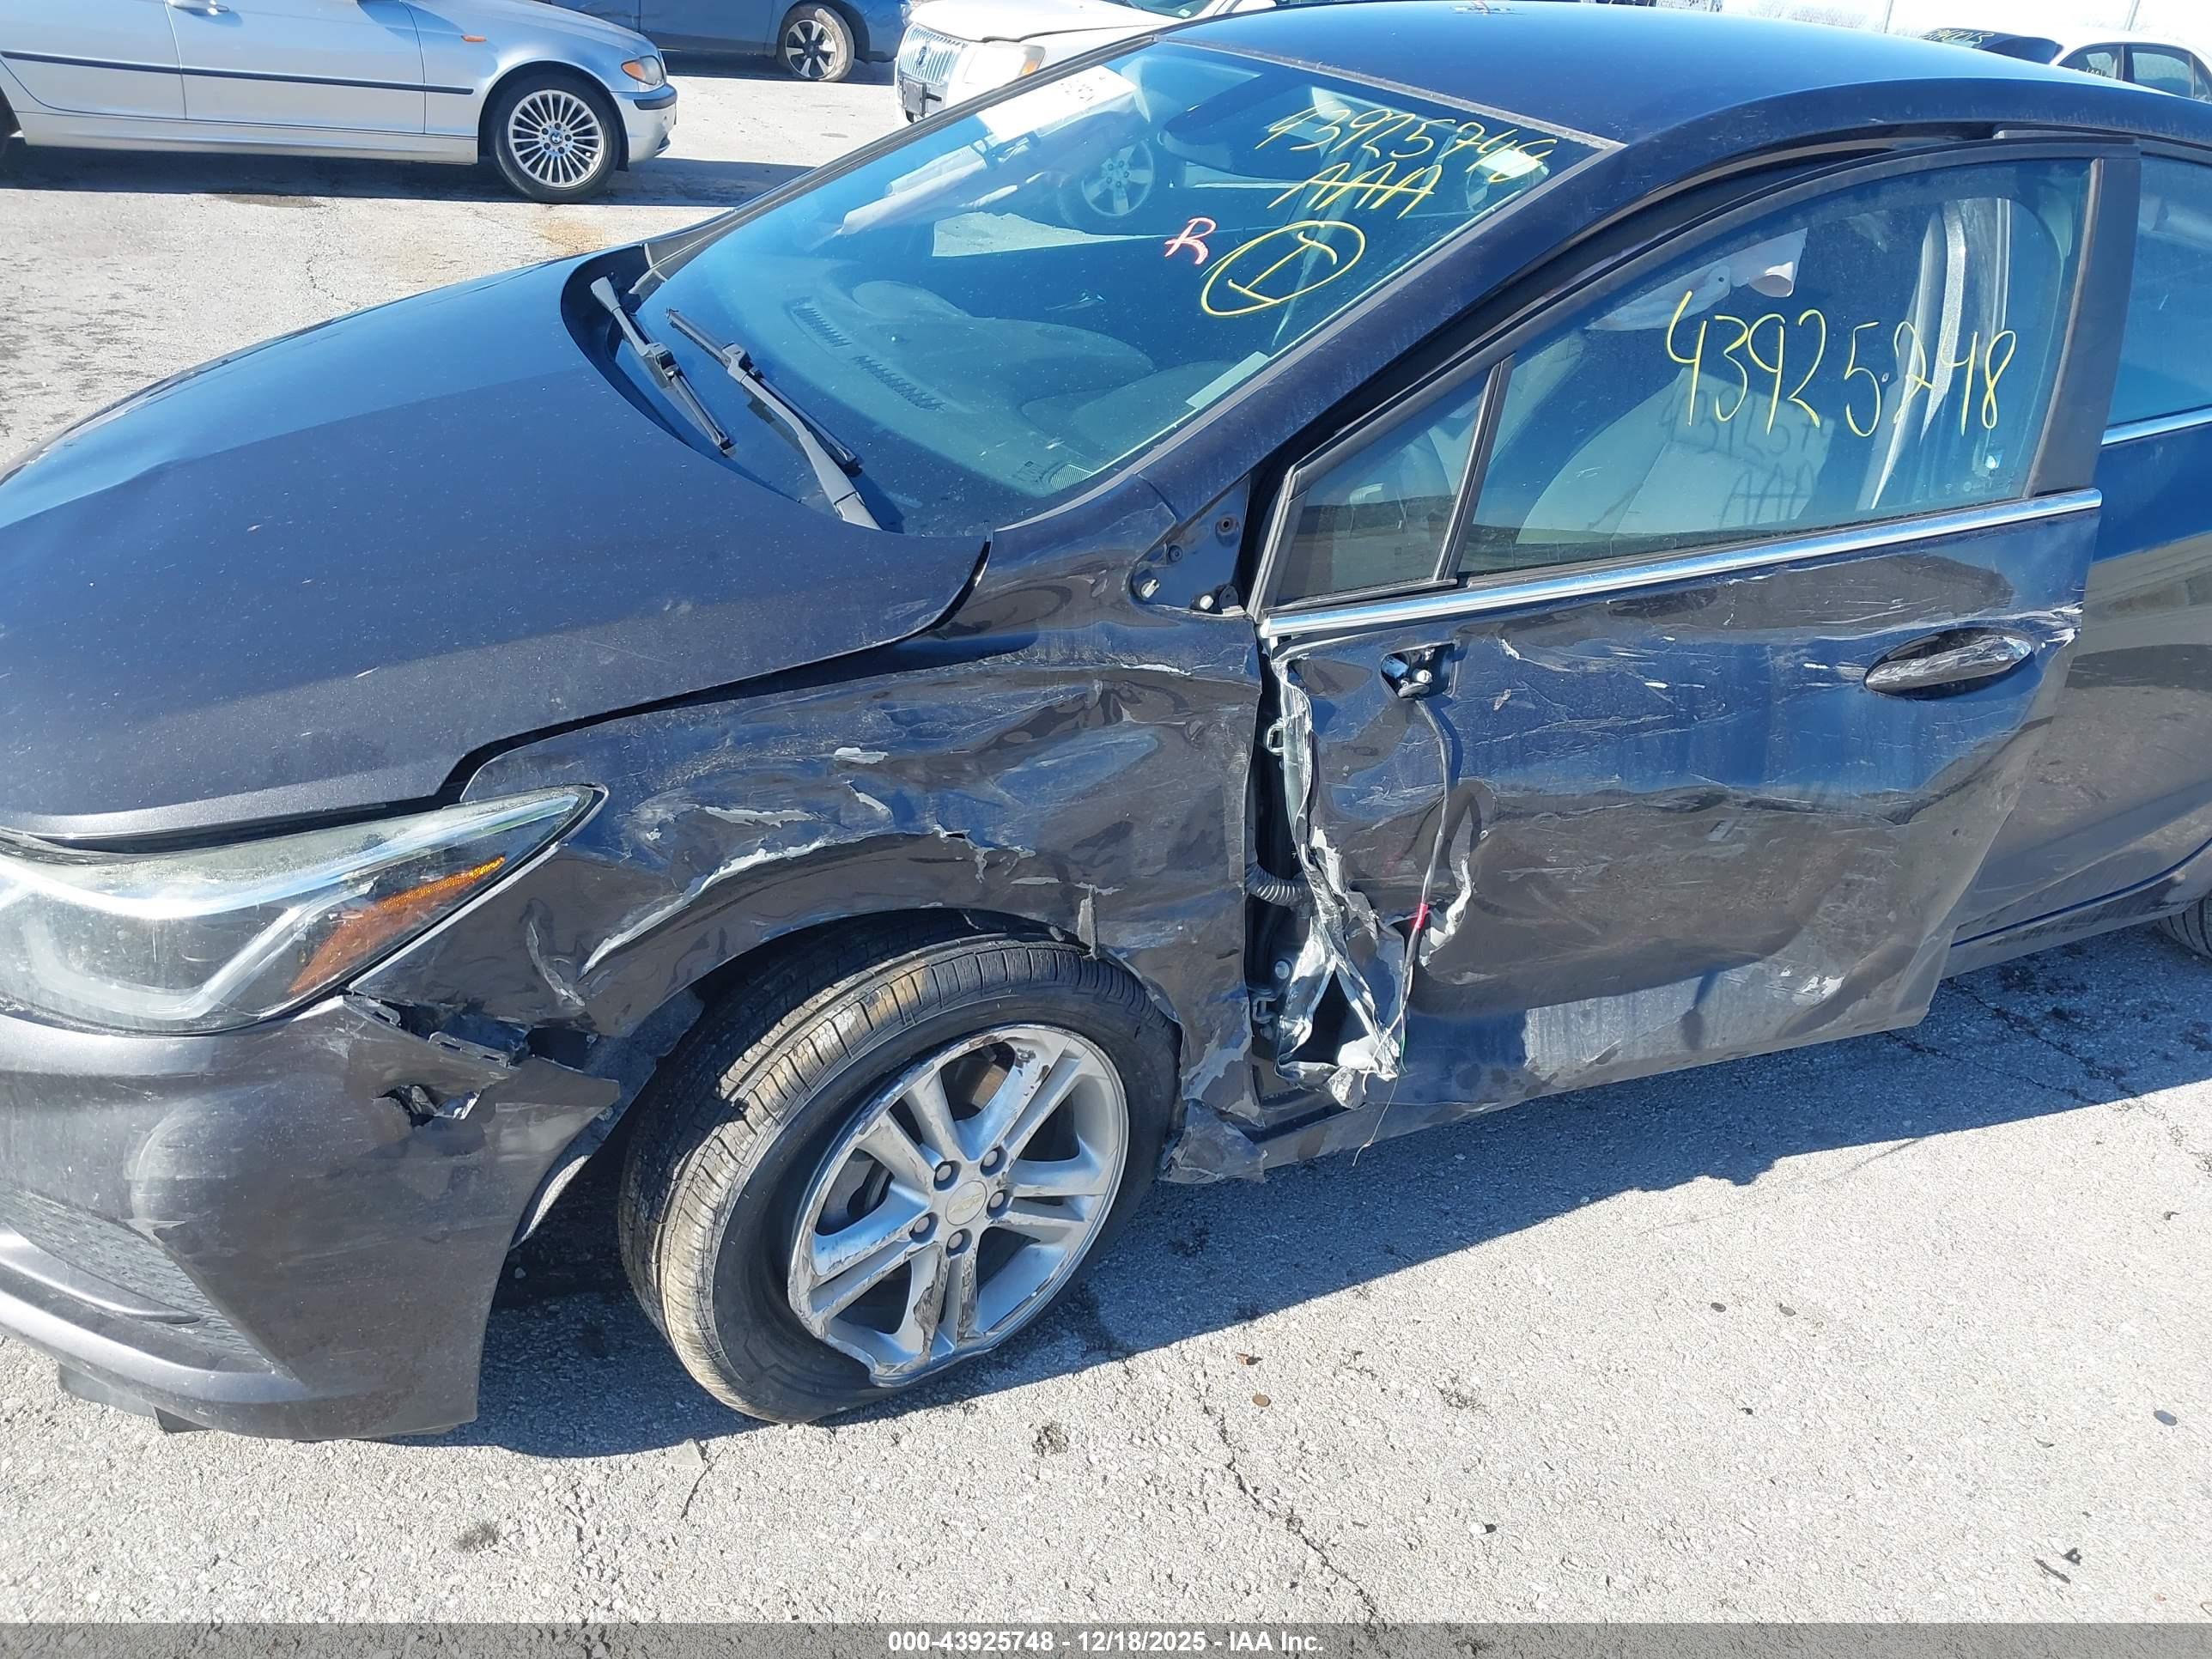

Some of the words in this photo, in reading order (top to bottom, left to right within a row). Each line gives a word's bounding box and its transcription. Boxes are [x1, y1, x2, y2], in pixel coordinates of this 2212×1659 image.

[1265, 161, 1443, 220] AAA
[1164, 216, 1217, 265] R
[1666, 289, 2017, 437] 43925748
